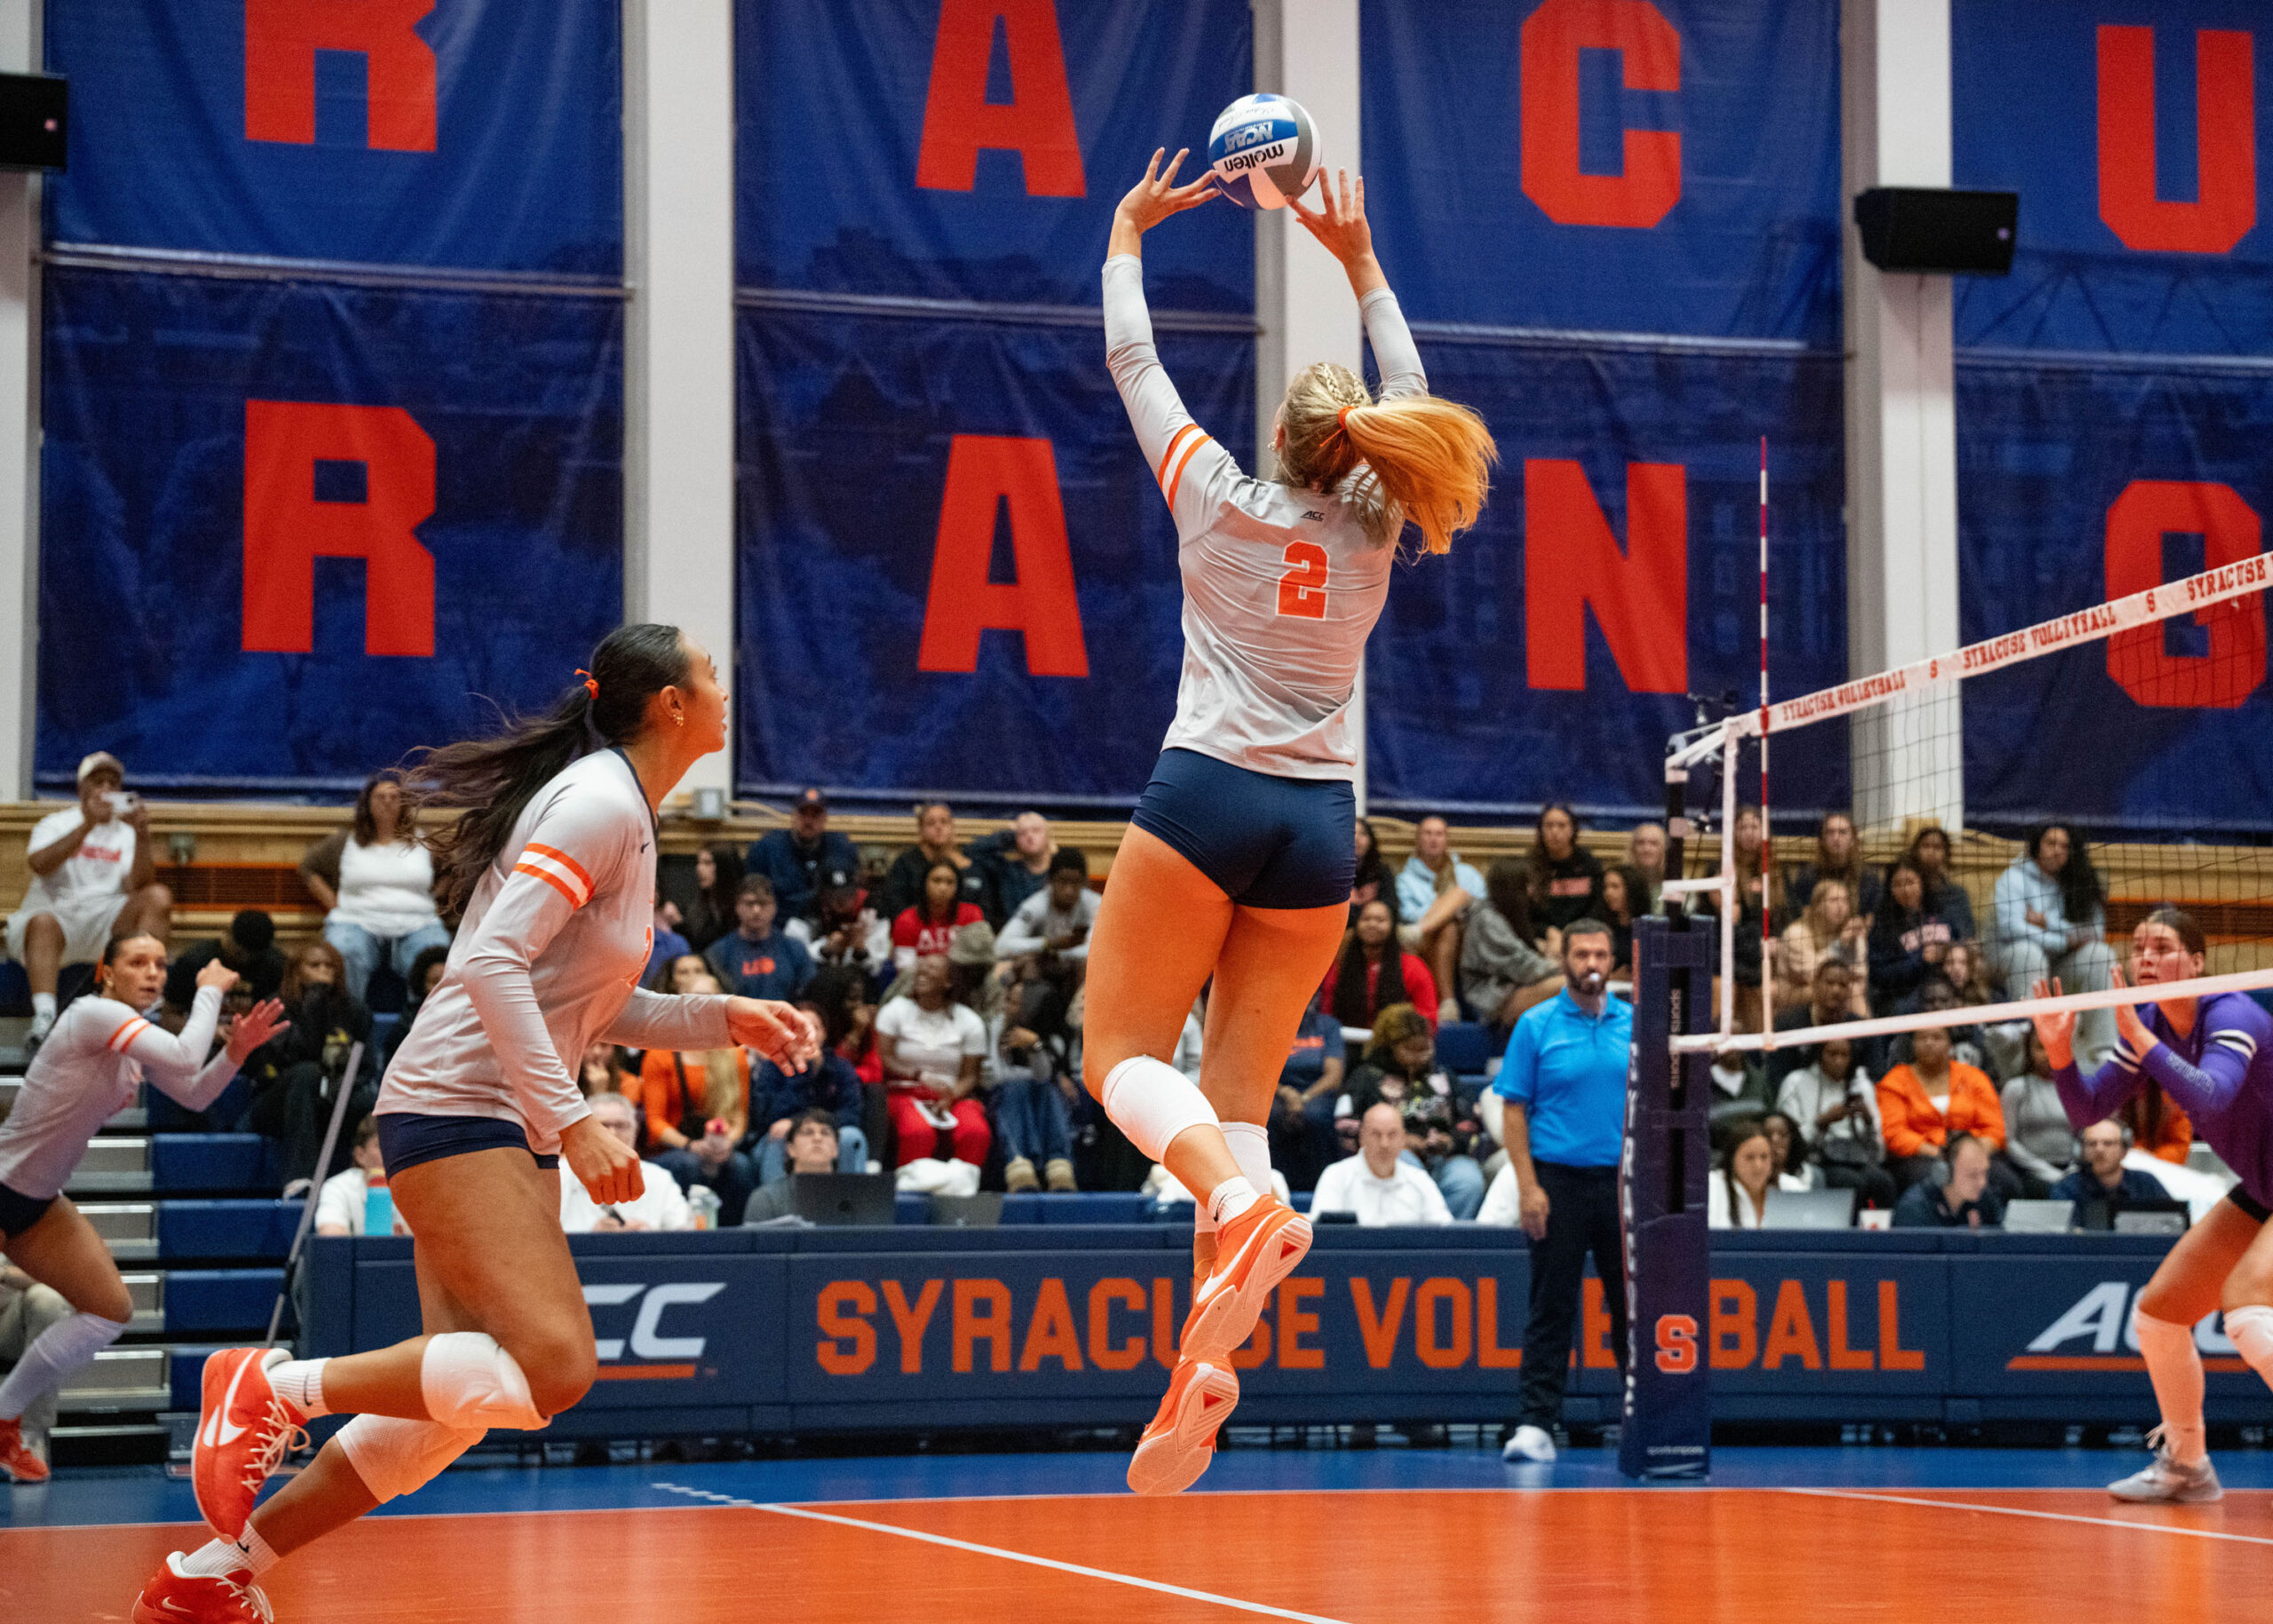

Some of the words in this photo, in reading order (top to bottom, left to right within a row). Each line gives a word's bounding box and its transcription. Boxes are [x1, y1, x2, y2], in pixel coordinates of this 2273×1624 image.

[916, 0, 1087, 197] A
[1224, 121, 1273, 152] NCAA
[1224, 143, 1285, 172] molten
[1521, 0, 1681, 228] C
[2096, 24, 2256, 253] U
[242, 399, 435, 657] R
[917, 433, 1089, 677] A
[1276, 539, 1329, 621] 2
[1302, 510, 1326, 521] ACC
[1524, 458, 1687, 693] N
[1963, 633, 2026, 669] SYRACUSE
[2187, 558, 2266, 601] SYRACUSE
[1350, 1277, 1925, 1371] VOLEBALL
